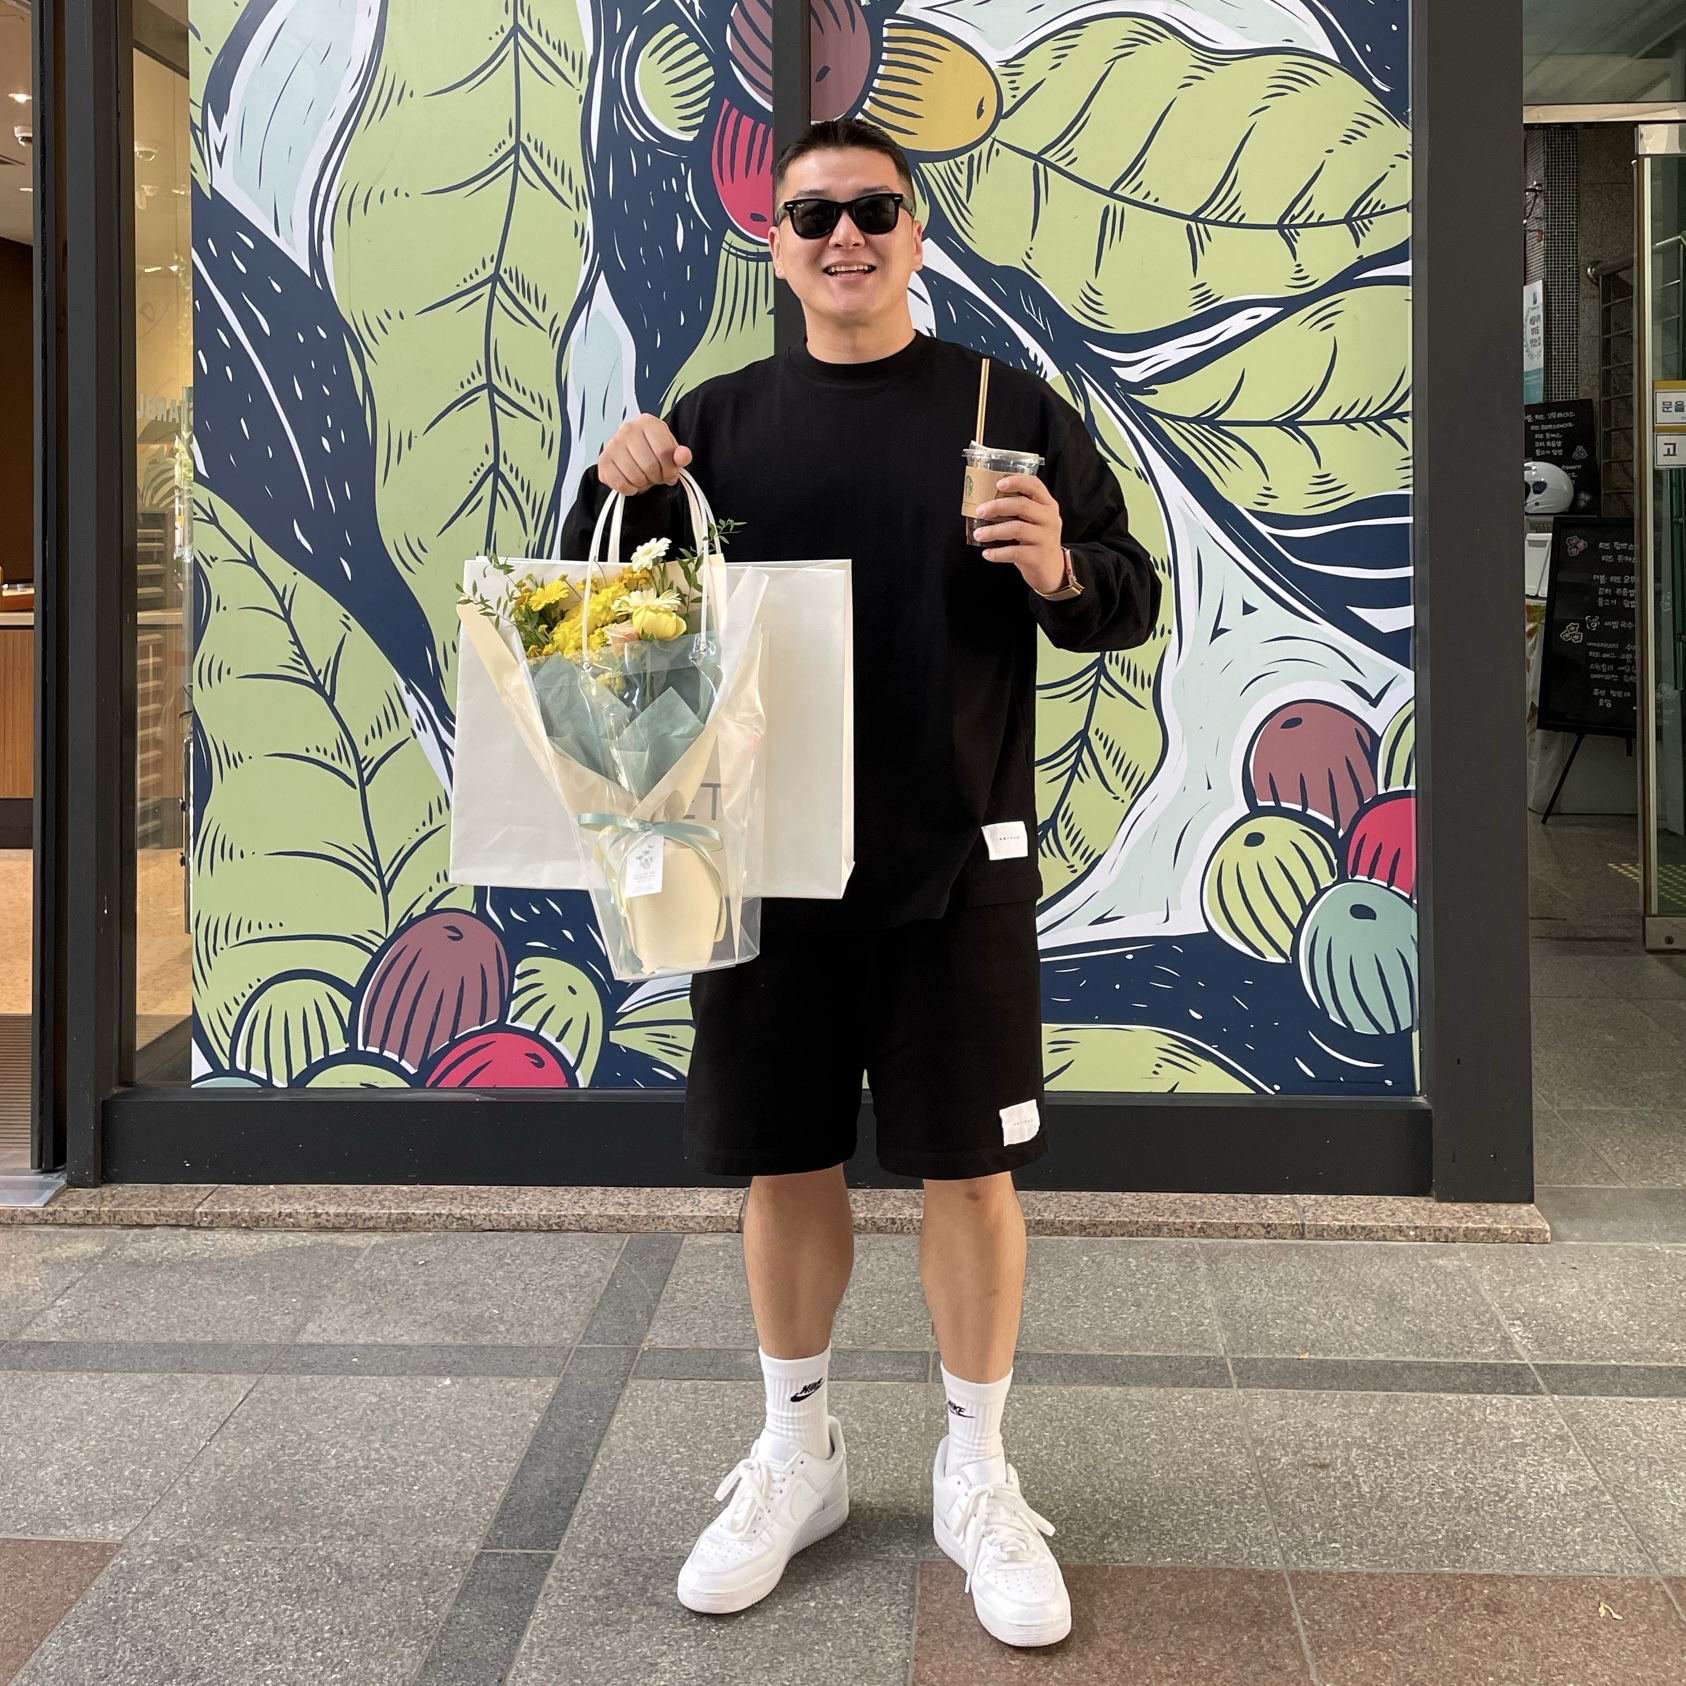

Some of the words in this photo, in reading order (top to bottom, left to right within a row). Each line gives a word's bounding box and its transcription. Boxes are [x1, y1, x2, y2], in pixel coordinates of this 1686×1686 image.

[1662, 401, 1685, 412] 문을
[1663, 443, 1677, 456] 고
[800, 1377, 823, 1394] NIKE
